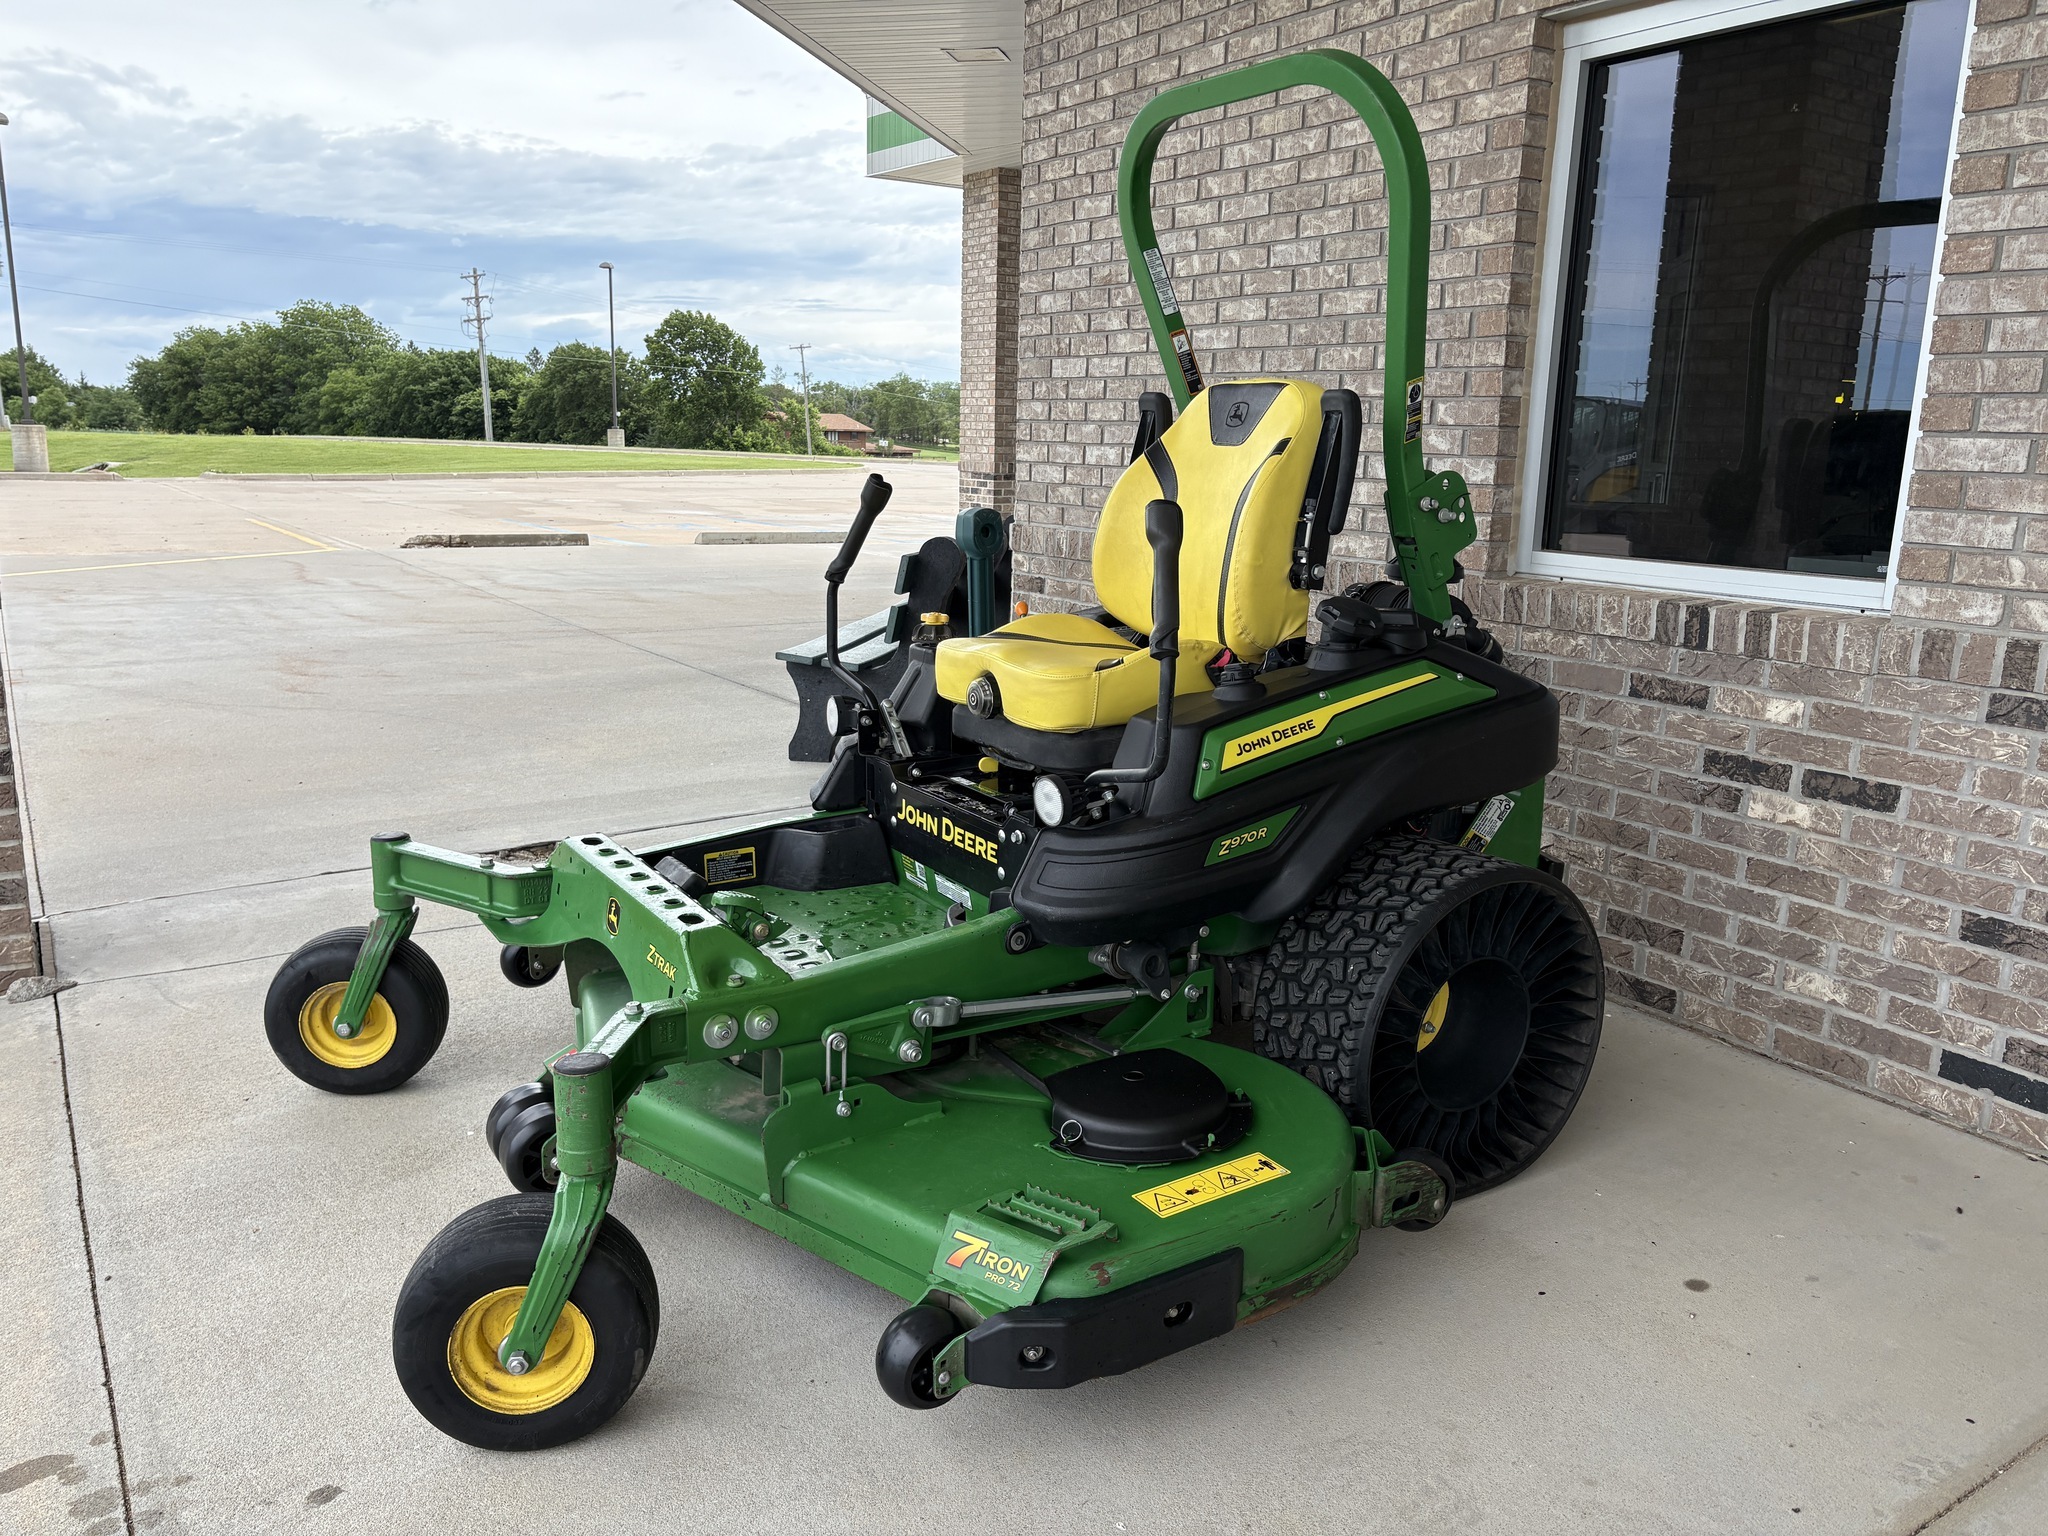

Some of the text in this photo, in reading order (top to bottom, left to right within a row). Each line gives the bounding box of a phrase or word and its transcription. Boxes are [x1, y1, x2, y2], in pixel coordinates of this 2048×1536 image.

[1236, 719, 1316, 757] JOHN DEERE
[897, 798, 938, 837] JOHN
[941, 816, 999, 864] DEERE
[1217, 827, 1268, 857] Z970R
[646, 943, 678, 982] ZTRAK
[984, 1271, 1021, 1291] PRO 72
